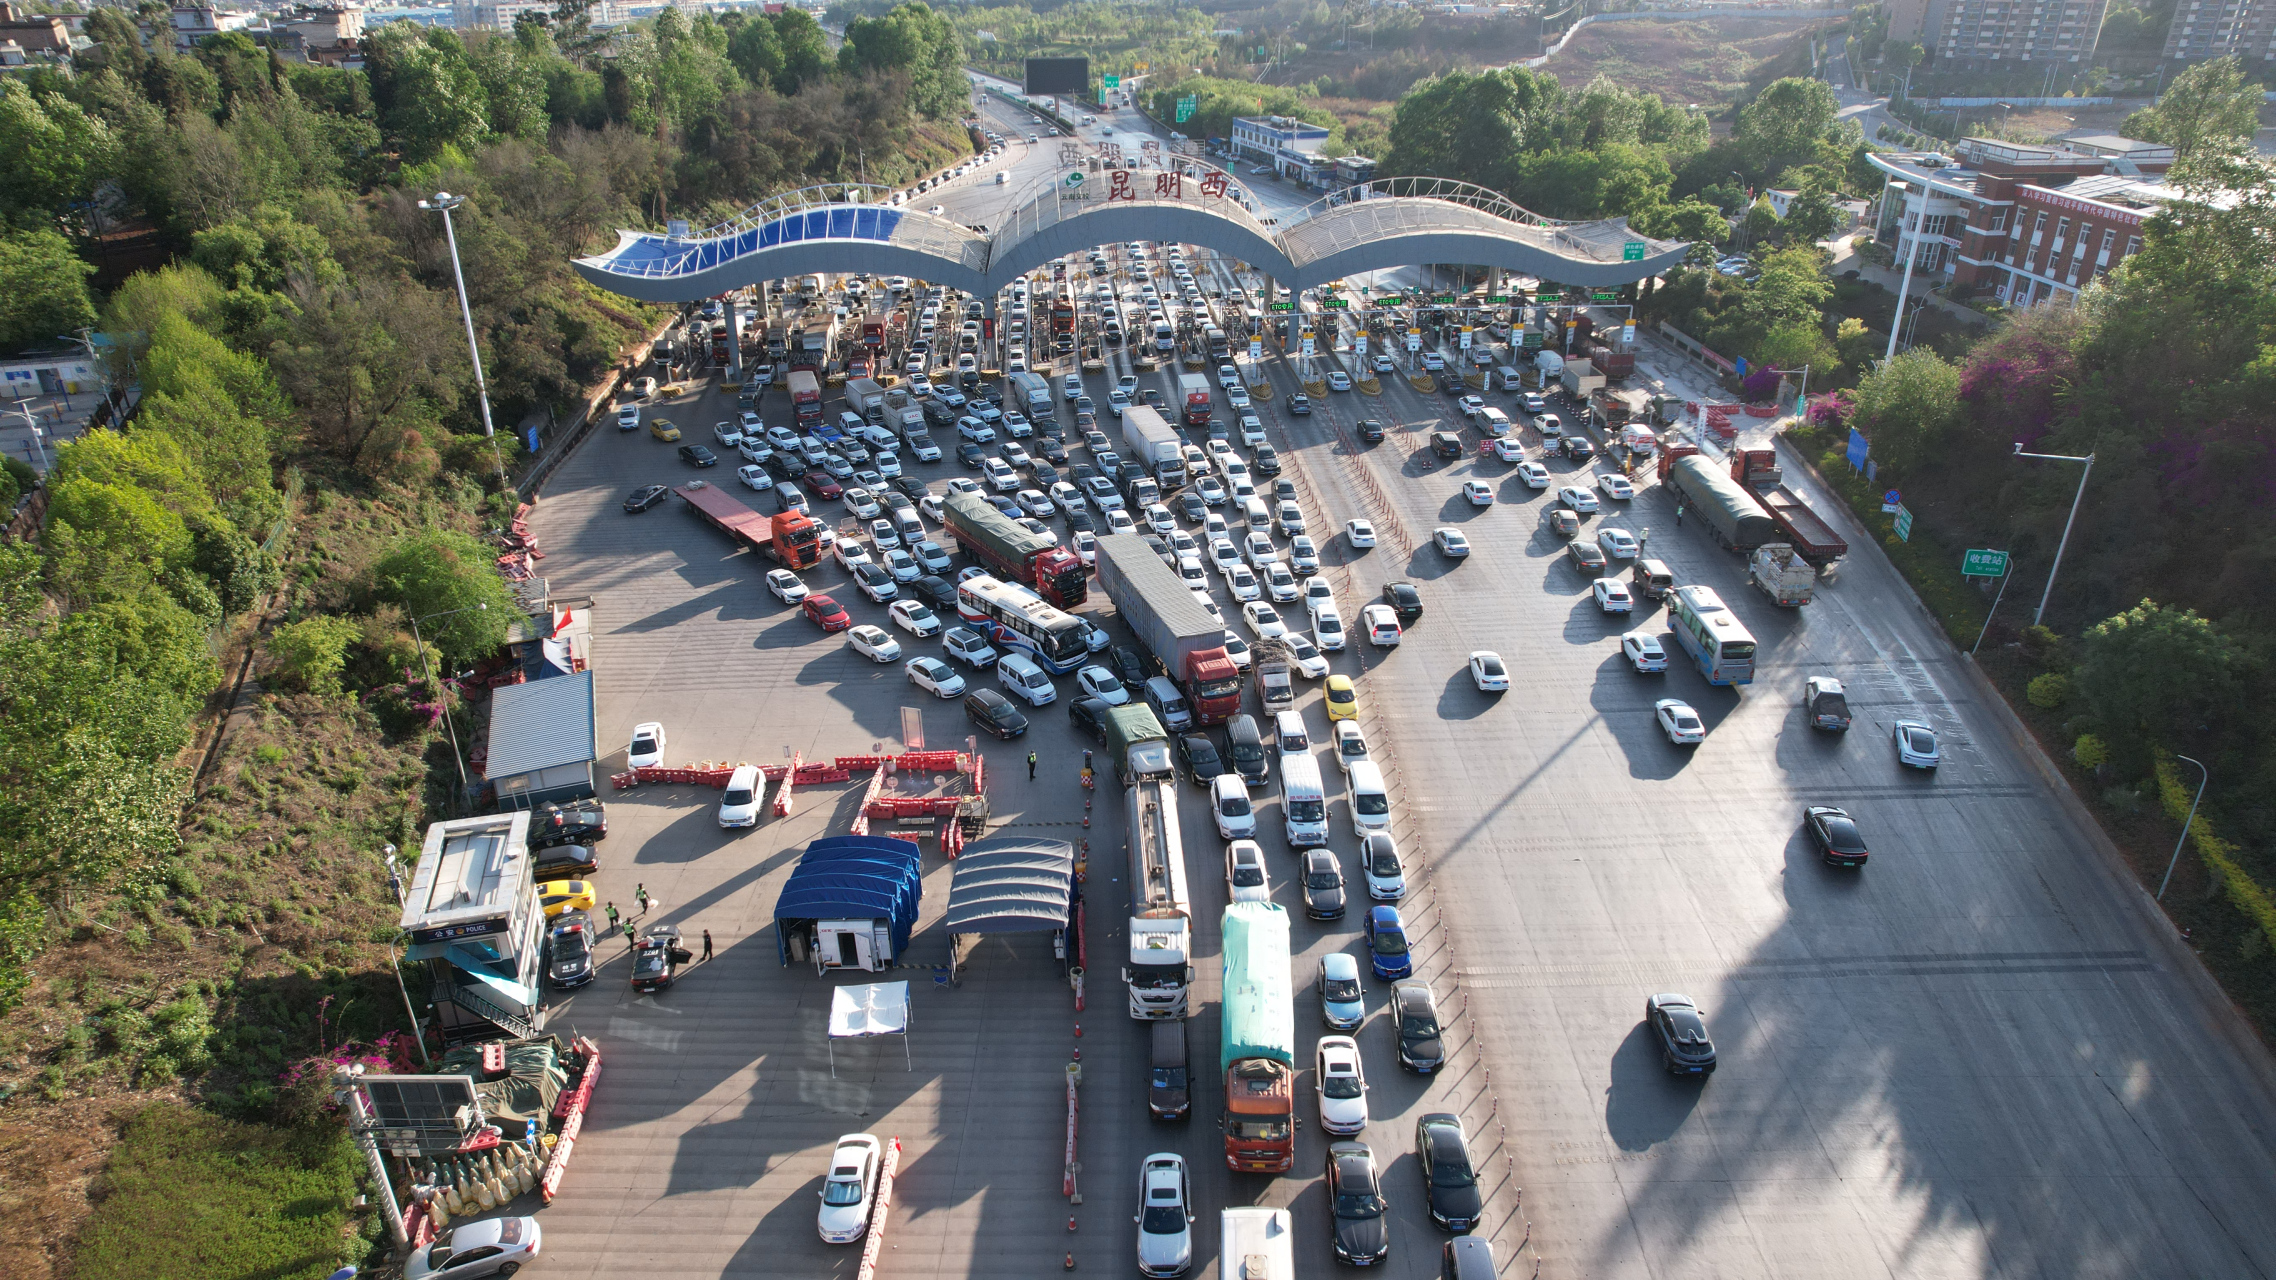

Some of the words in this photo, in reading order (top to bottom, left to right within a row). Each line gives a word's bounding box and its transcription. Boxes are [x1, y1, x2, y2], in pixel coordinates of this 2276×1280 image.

[1108, 171, 1228, 200] 昆明西
[1969, 553, 2003, 565] 收费站
[434, 929, 455, 938] 公安
[465, 924, 487, 933] POLICE
